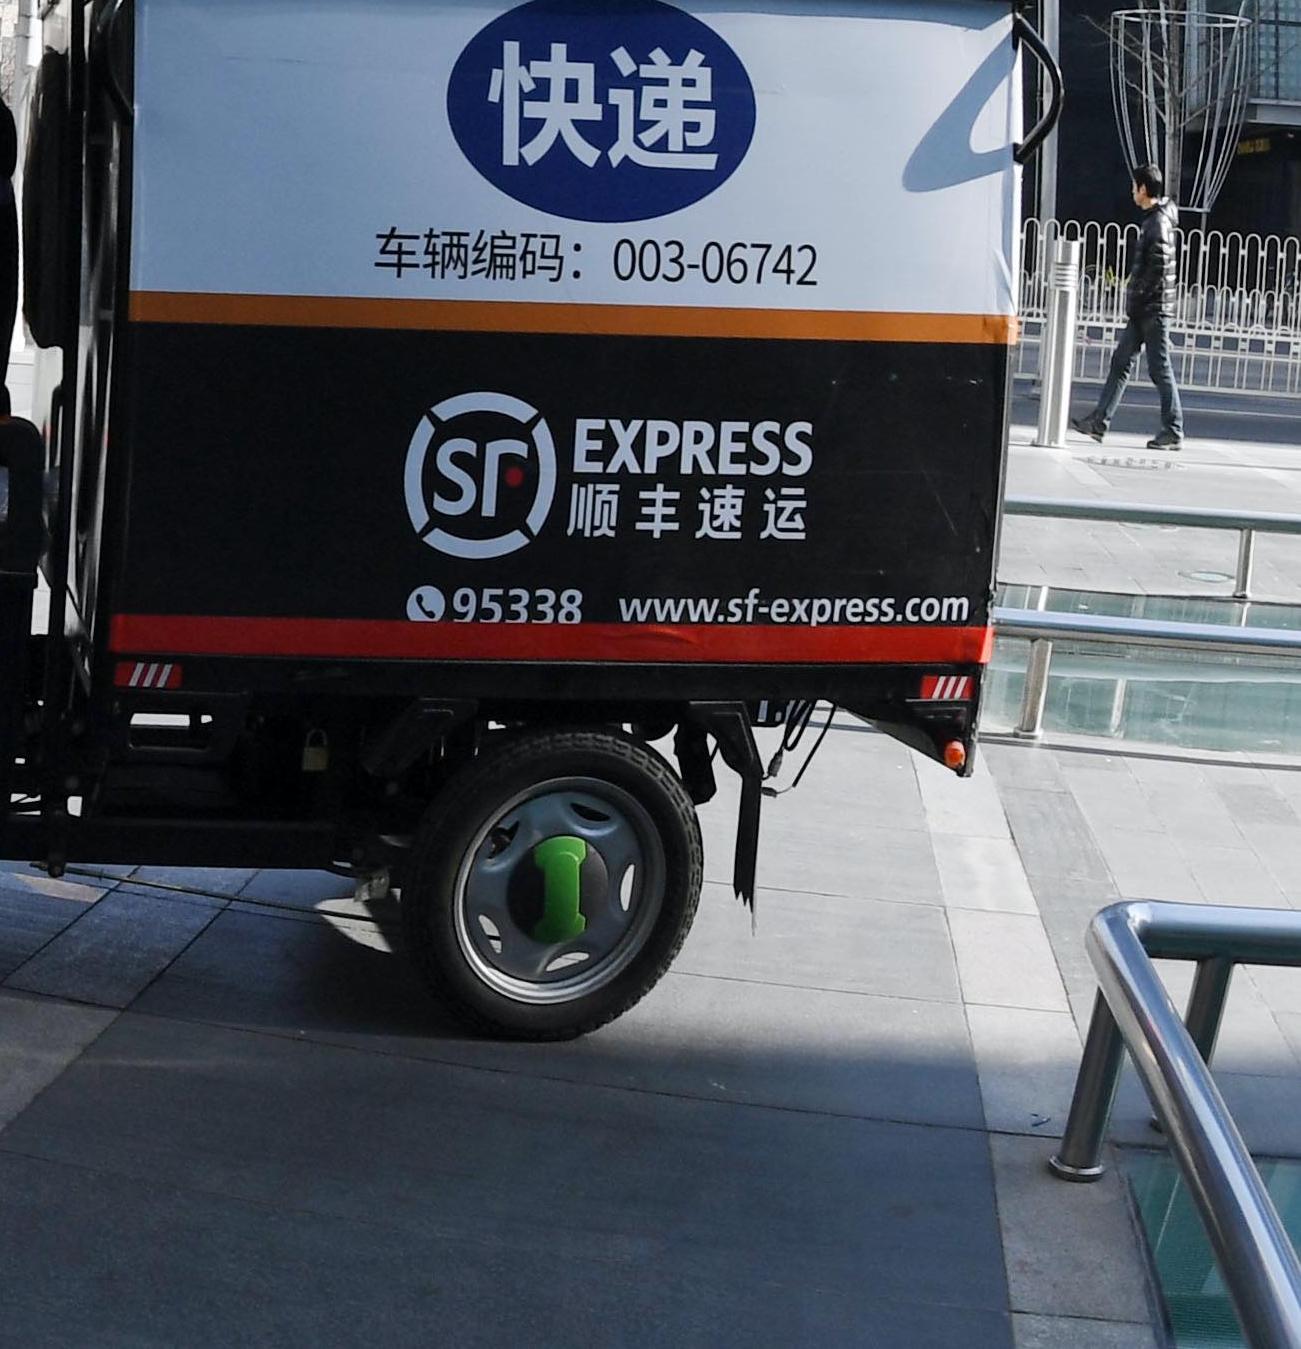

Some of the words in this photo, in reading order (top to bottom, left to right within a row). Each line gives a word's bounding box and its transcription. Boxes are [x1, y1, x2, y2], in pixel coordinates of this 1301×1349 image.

[487, 41, 718, 171] 快递
[612, 238, 817, 287] 003-06742
[573, 418, 814, 476] EXPRESS
[567, 483, 808, 540] 顺丰速运
[452, 586, 582, 625] 95338
[618, 588, 970, 627] www.sf-express.com
